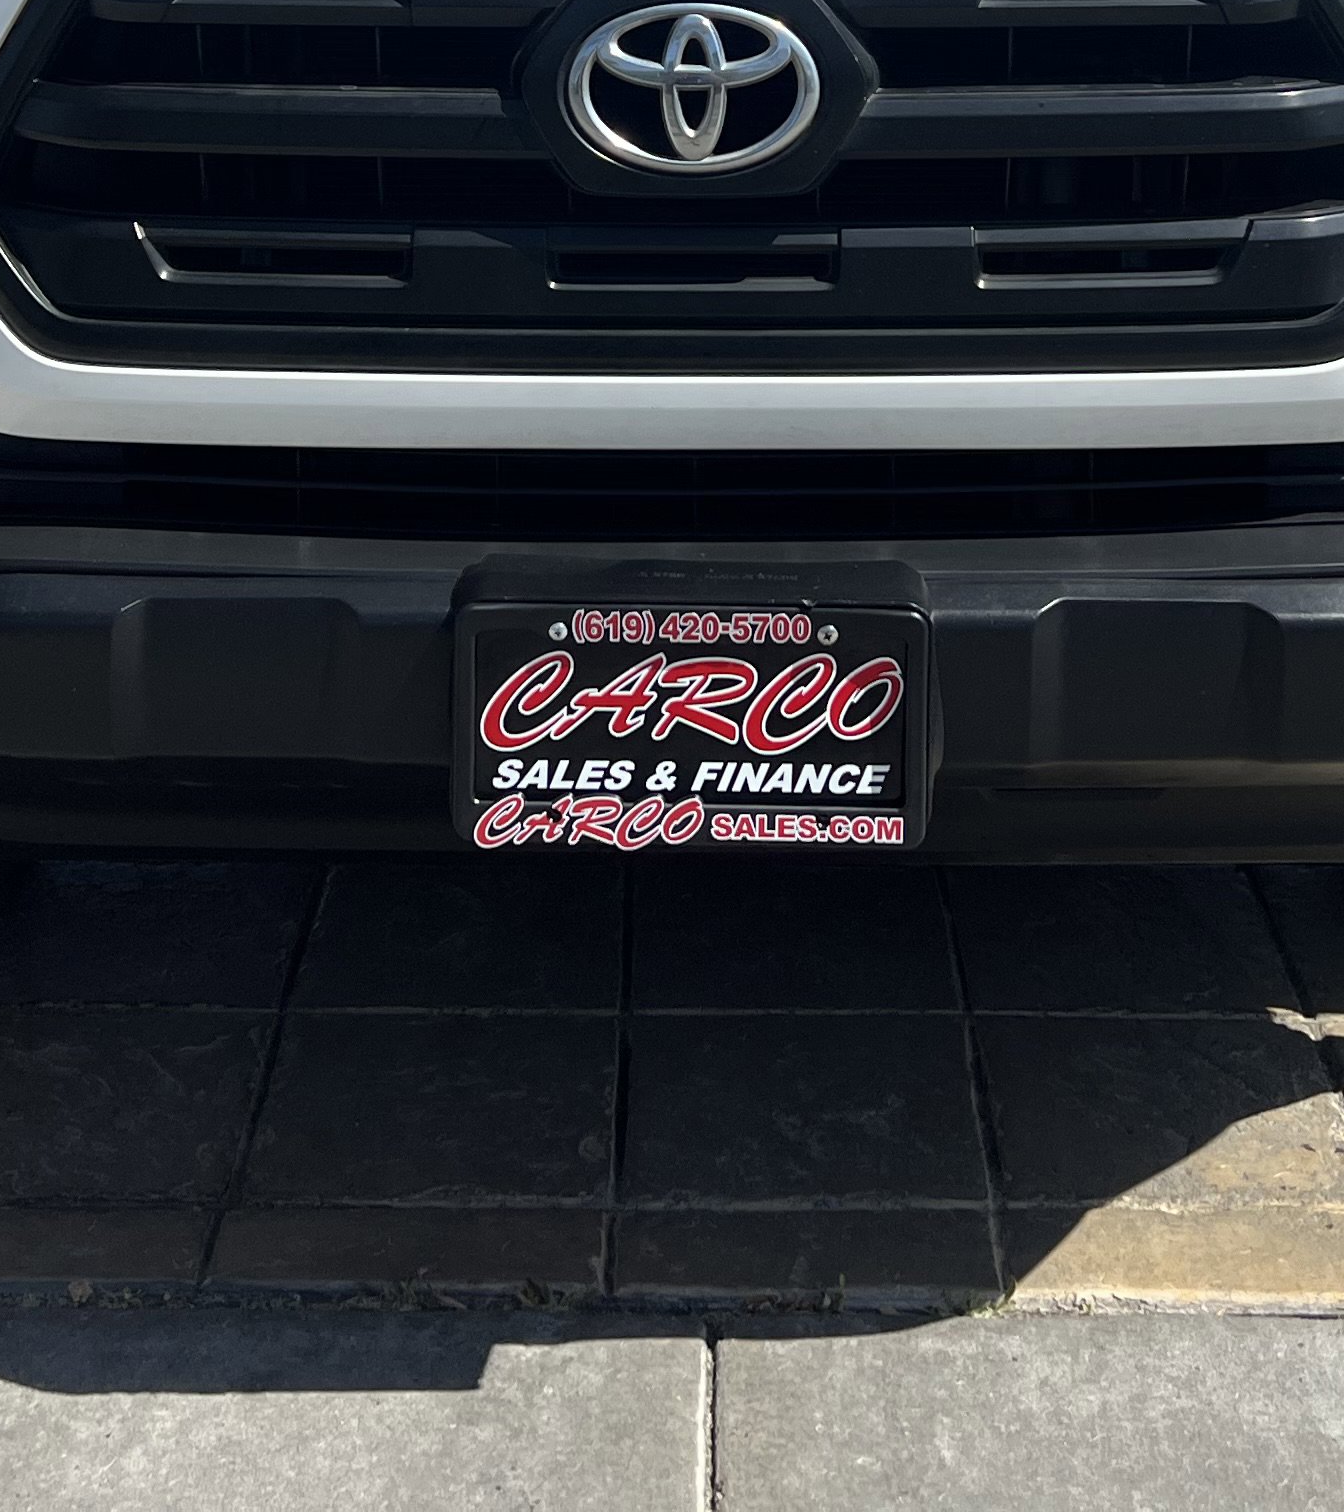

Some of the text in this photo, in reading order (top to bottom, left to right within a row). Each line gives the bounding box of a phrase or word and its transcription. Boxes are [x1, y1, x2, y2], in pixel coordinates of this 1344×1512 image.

[571, 609, 812, 645] (619) 420-5700
[479, 650, 905, 756] CARCO
[491, 758, 891, 796] SALES & FINANCE
[472, 793, 905, 852] CARCO SALES.COM
